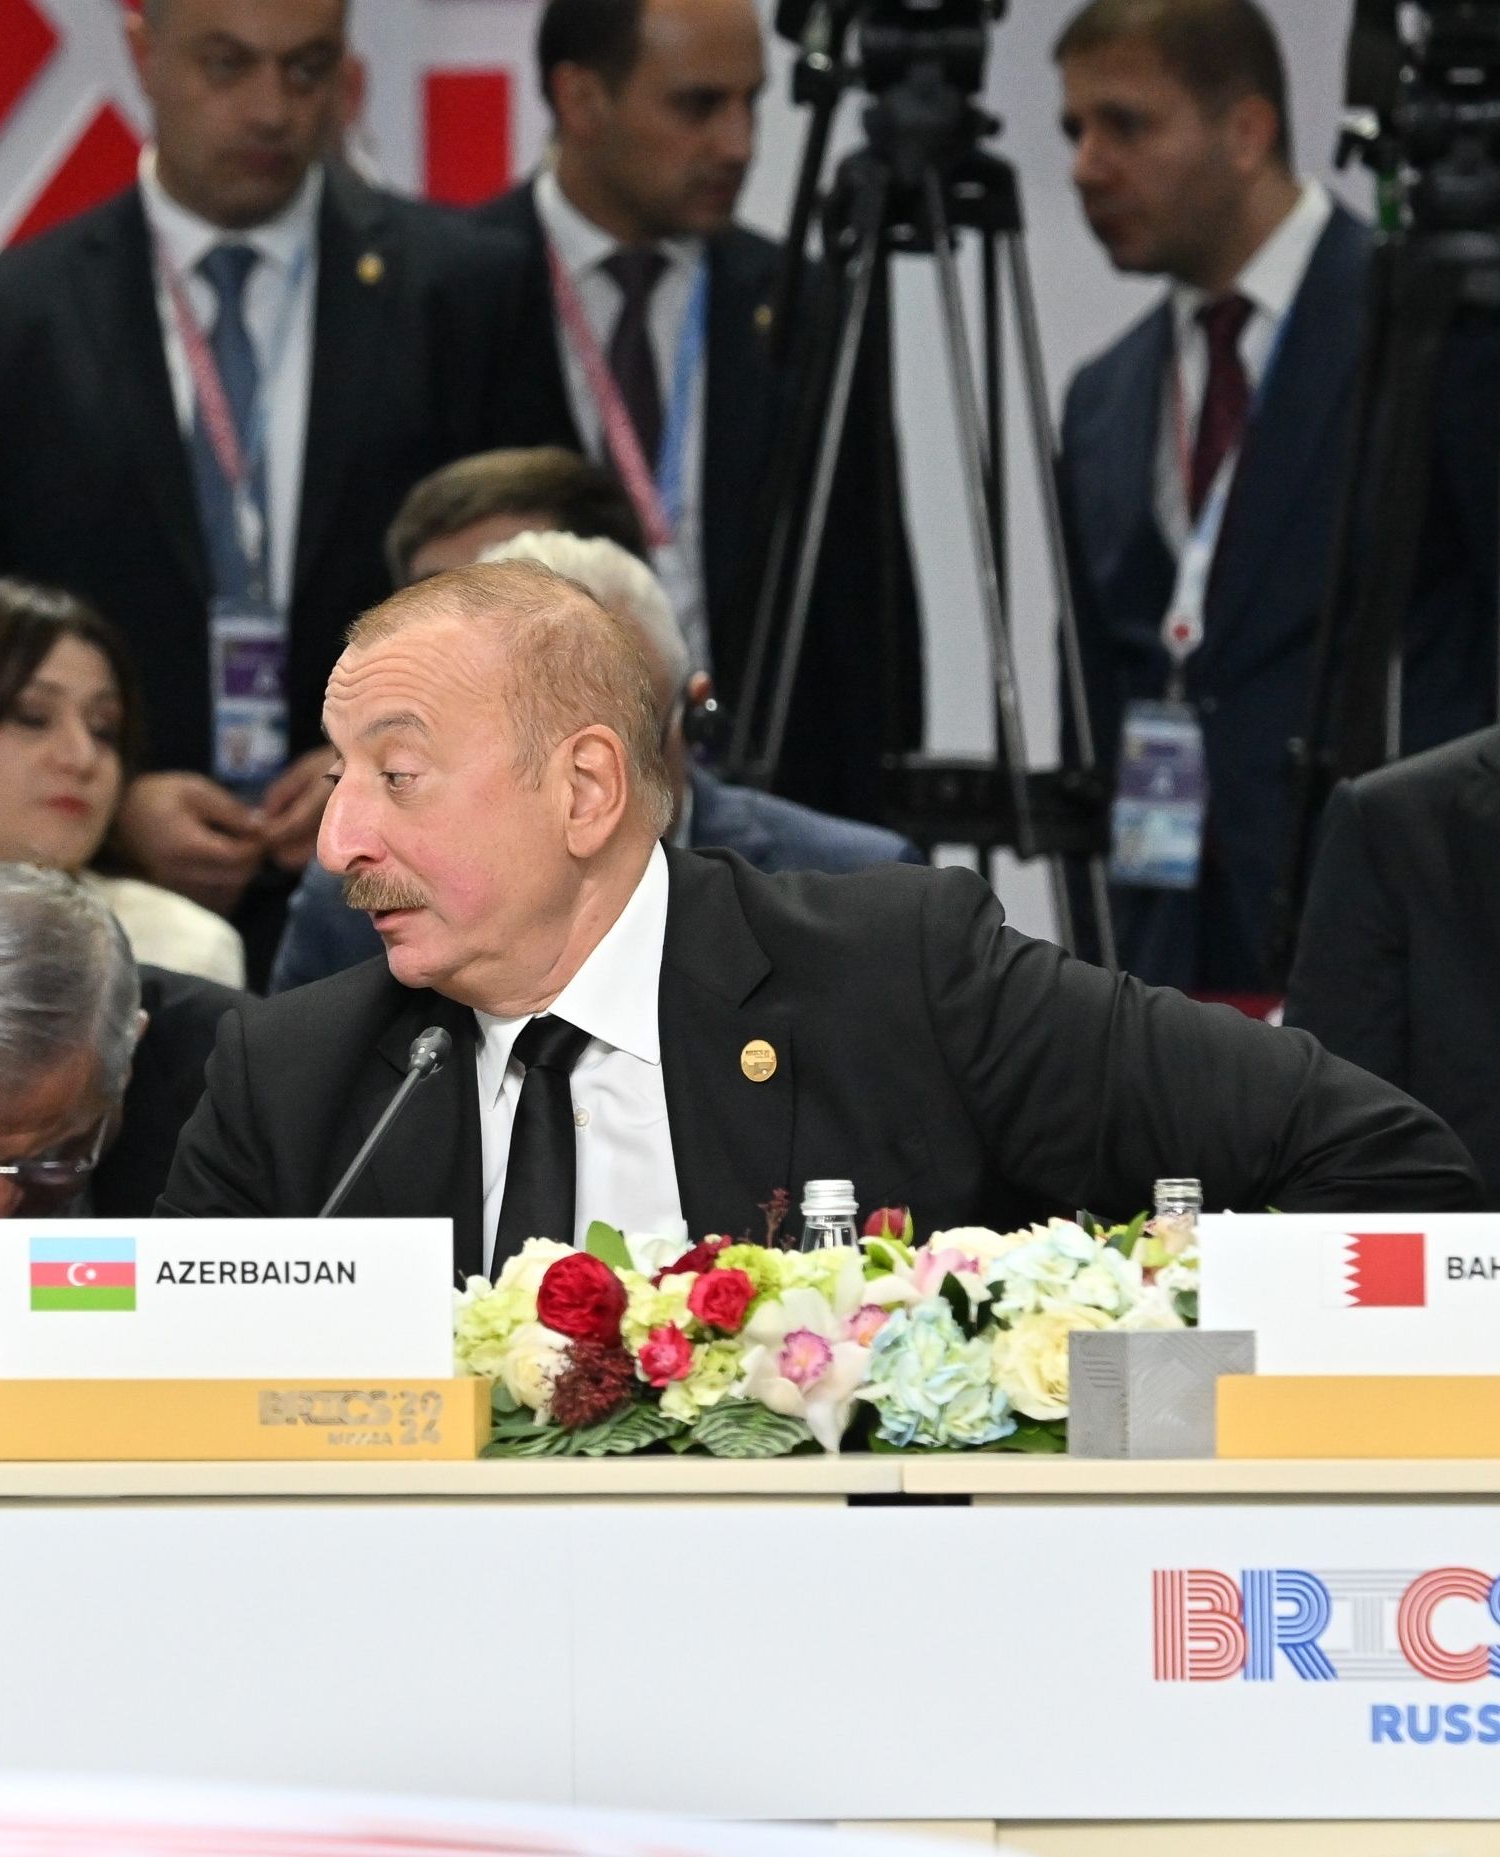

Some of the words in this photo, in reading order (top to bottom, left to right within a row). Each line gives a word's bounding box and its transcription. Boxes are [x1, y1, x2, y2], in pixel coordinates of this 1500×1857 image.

[155, 1260, 356, 1285] AZERBAIJAN
[1447, 1256, 1500, 1280] BAH
[1152, 1566, 1500, 1683] BRIC
[1371, 1704, 1500, 1743] RUSS
